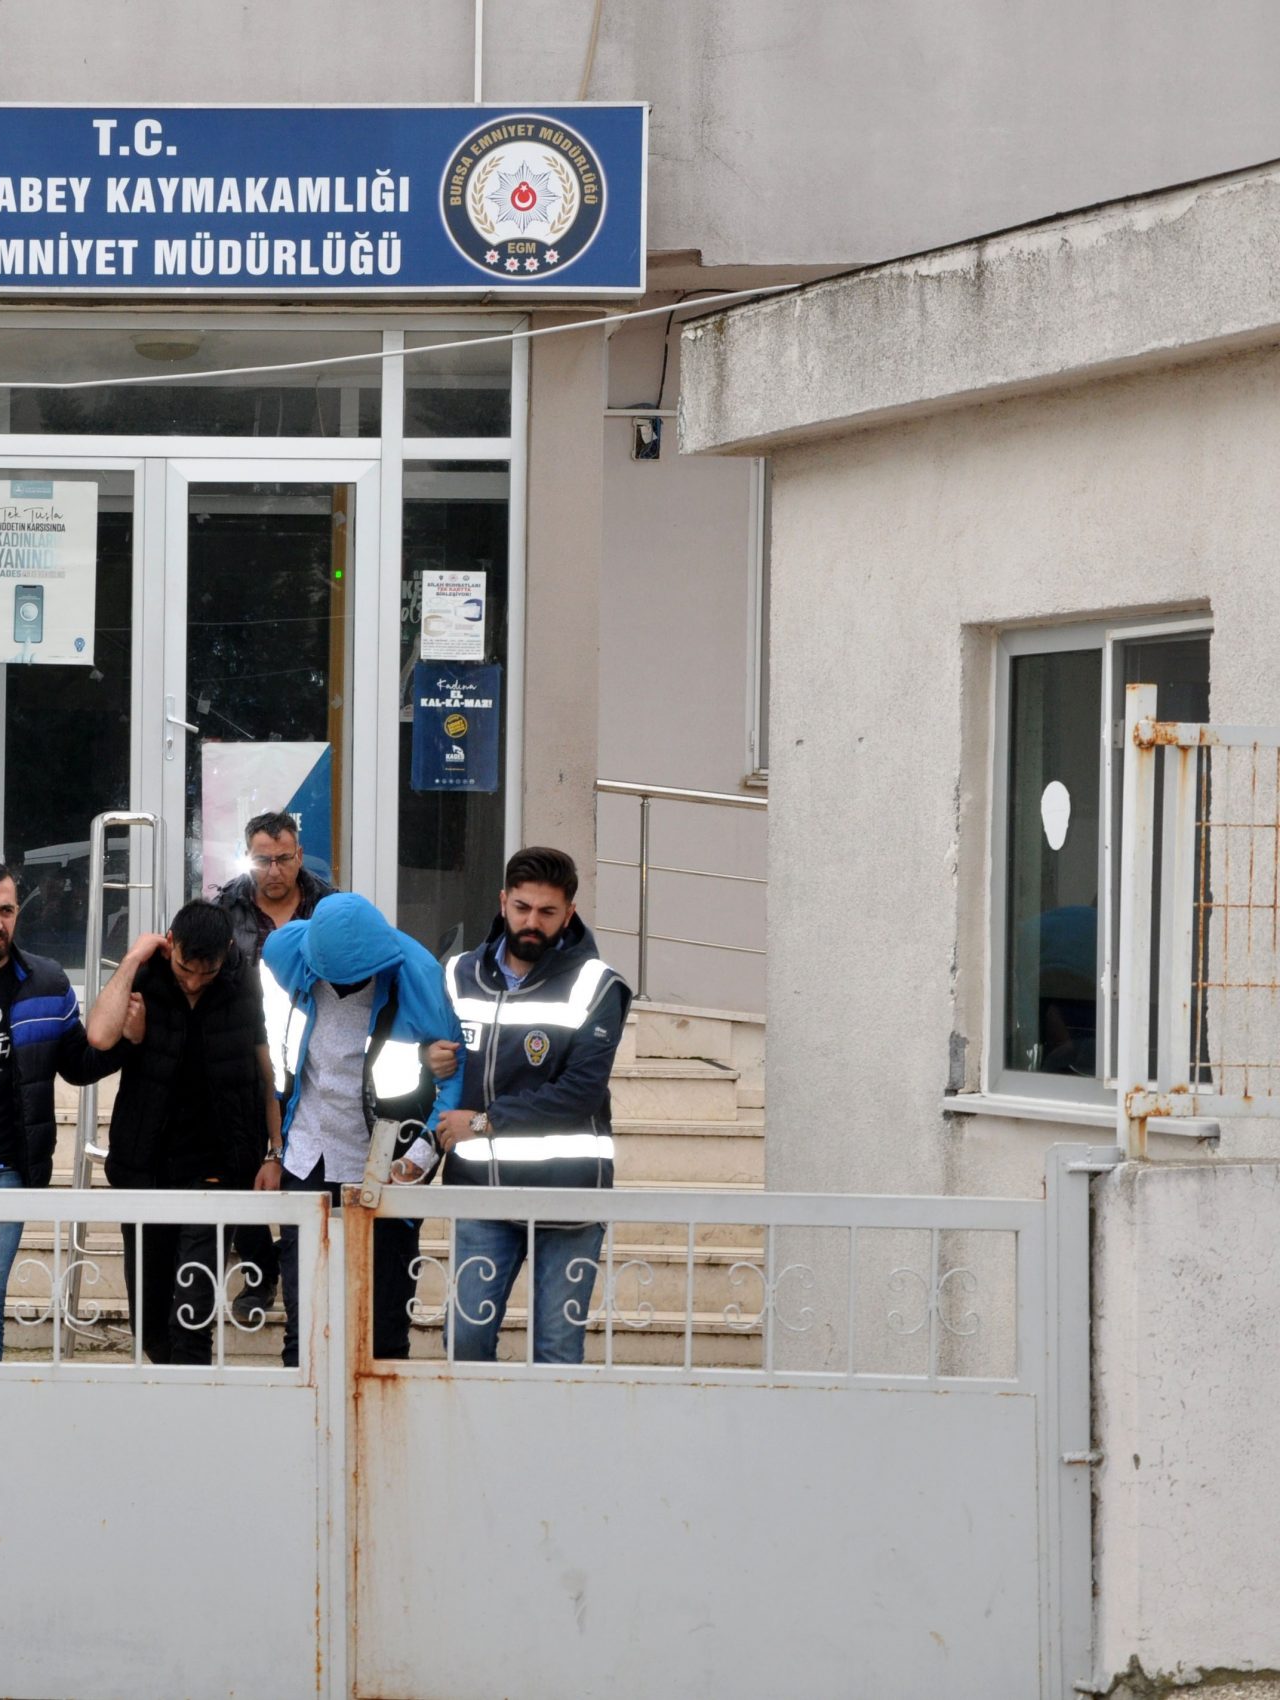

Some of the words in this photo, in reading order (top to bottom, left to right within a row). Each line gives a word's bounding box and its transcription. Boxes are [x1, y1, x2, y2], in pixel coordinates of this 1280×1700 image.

[92, 117, 178, 157] T.C.
[450, 156, 474, 206] BURSA
[470, 124, 535, 156] EMNİYET
[538, 126, 599, 205] MÜDÜRLÜĞÜ
[106, 168, 410, 213] KAYMAKAMLIĞI
[153, 231, 402, 276] MÜDÜRLÜĞÜ
[507, 242, 537, 254] EGM
[450, 690, 463, 699] EL
